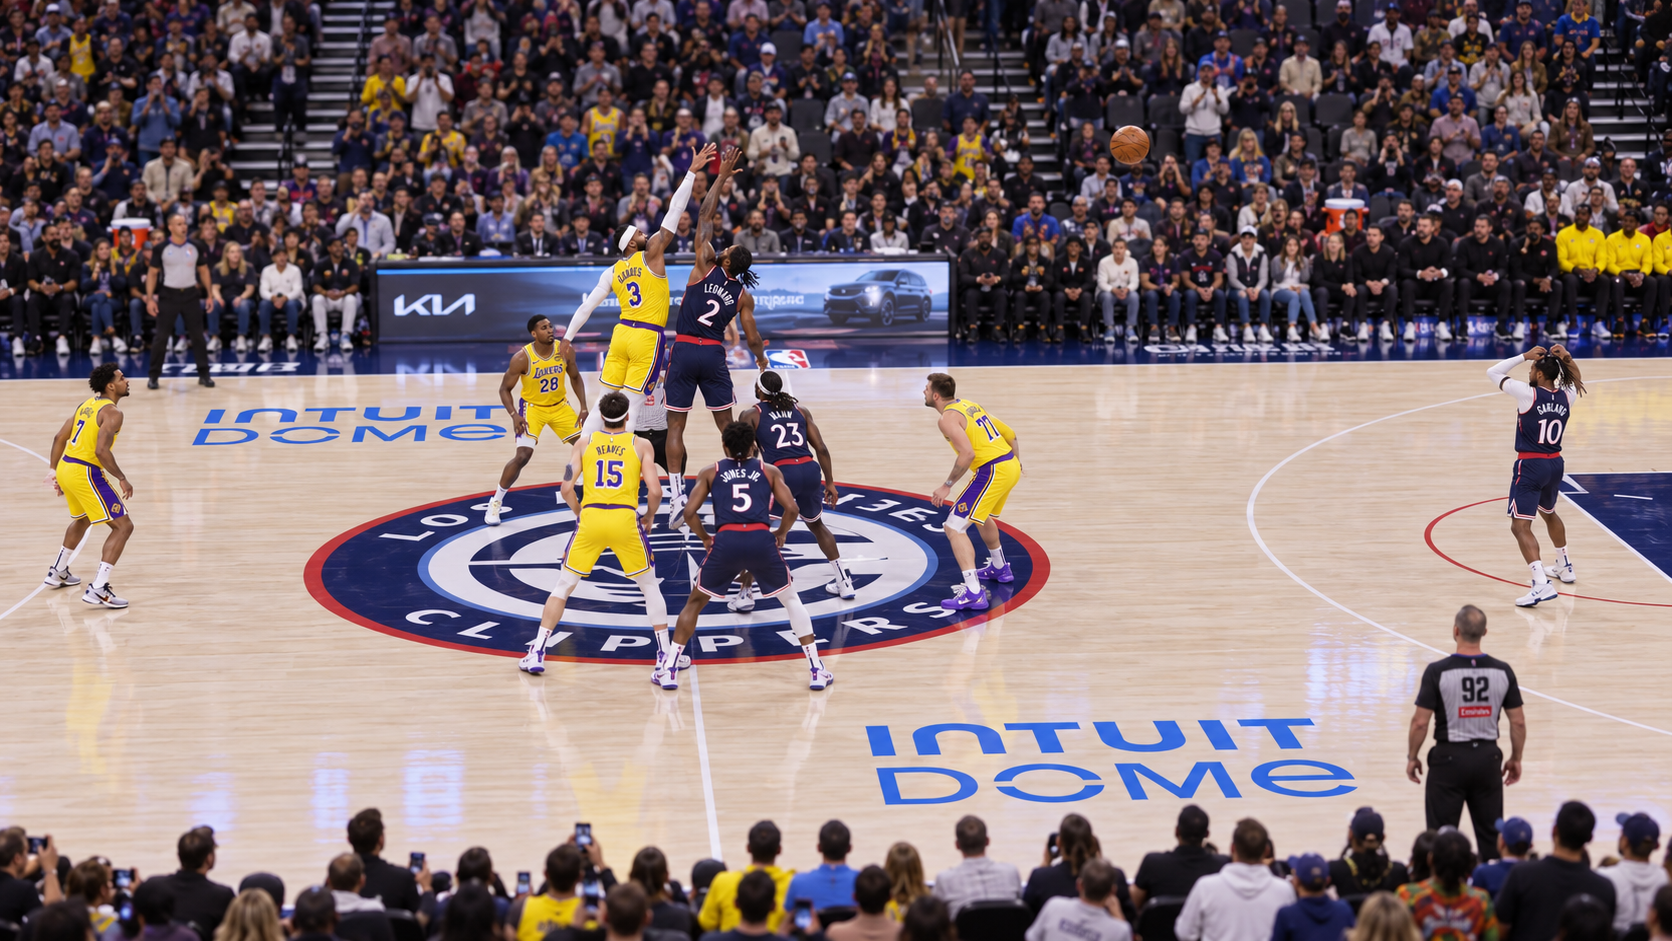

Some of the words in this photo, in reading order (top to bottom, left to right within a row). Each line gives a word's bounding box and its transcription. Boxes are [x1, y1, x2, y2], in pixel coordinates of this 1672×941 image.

[626, 281, 643, 308] 3
[697, 299, 721, 327] 2
[540, 376, 559, 393] 28
[203, 404, 507, 425] INTUIT
[975, 414, 1000, 442] 77
[71, 419, 86, 445] 7
[191, 424, 508, 447] DOME
[770, 422, 804, 449] 23
[1537, 418, 1563, 445] 10
[594, 459, 625, 489] 15
[731, 483, 753, 513] 5
[1461, 676, 1489, 702] 92
[865, 718, 1315, 757] INTUIT
[876, 759, 1359, 805] DOME
